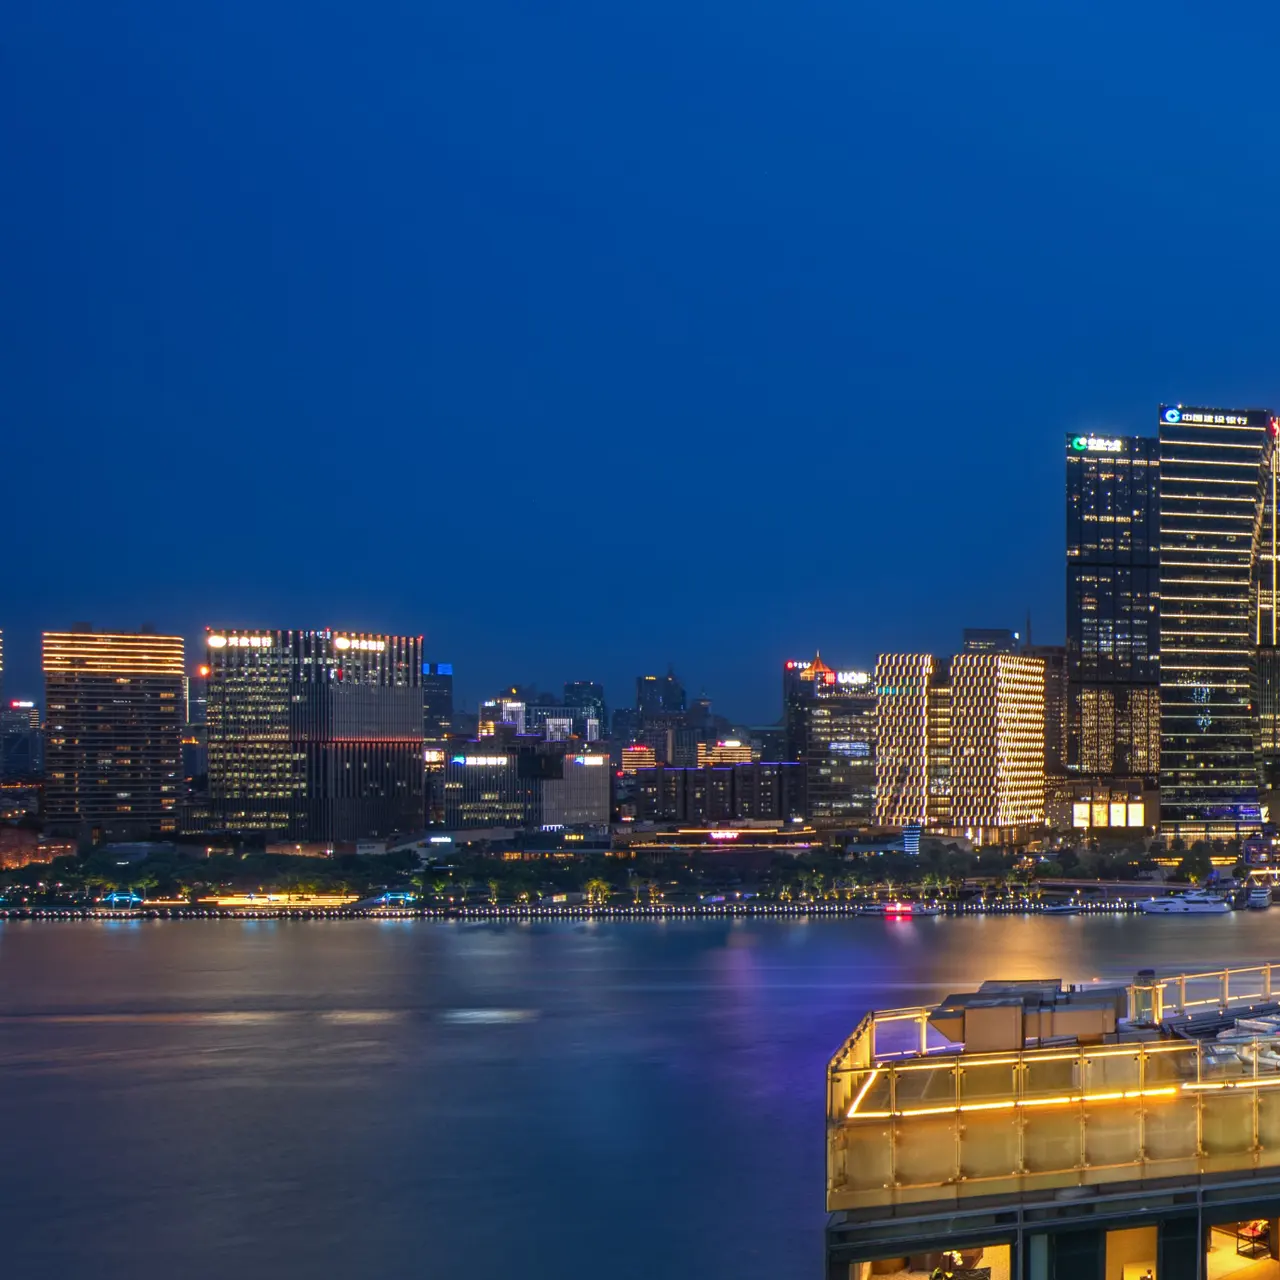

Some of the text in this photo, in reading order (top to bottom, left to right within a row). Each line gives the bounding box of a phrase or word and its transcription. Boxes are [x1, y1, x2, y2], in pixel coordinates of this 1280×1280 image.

[1182, 413, 1248, 425] 中国建设银行
